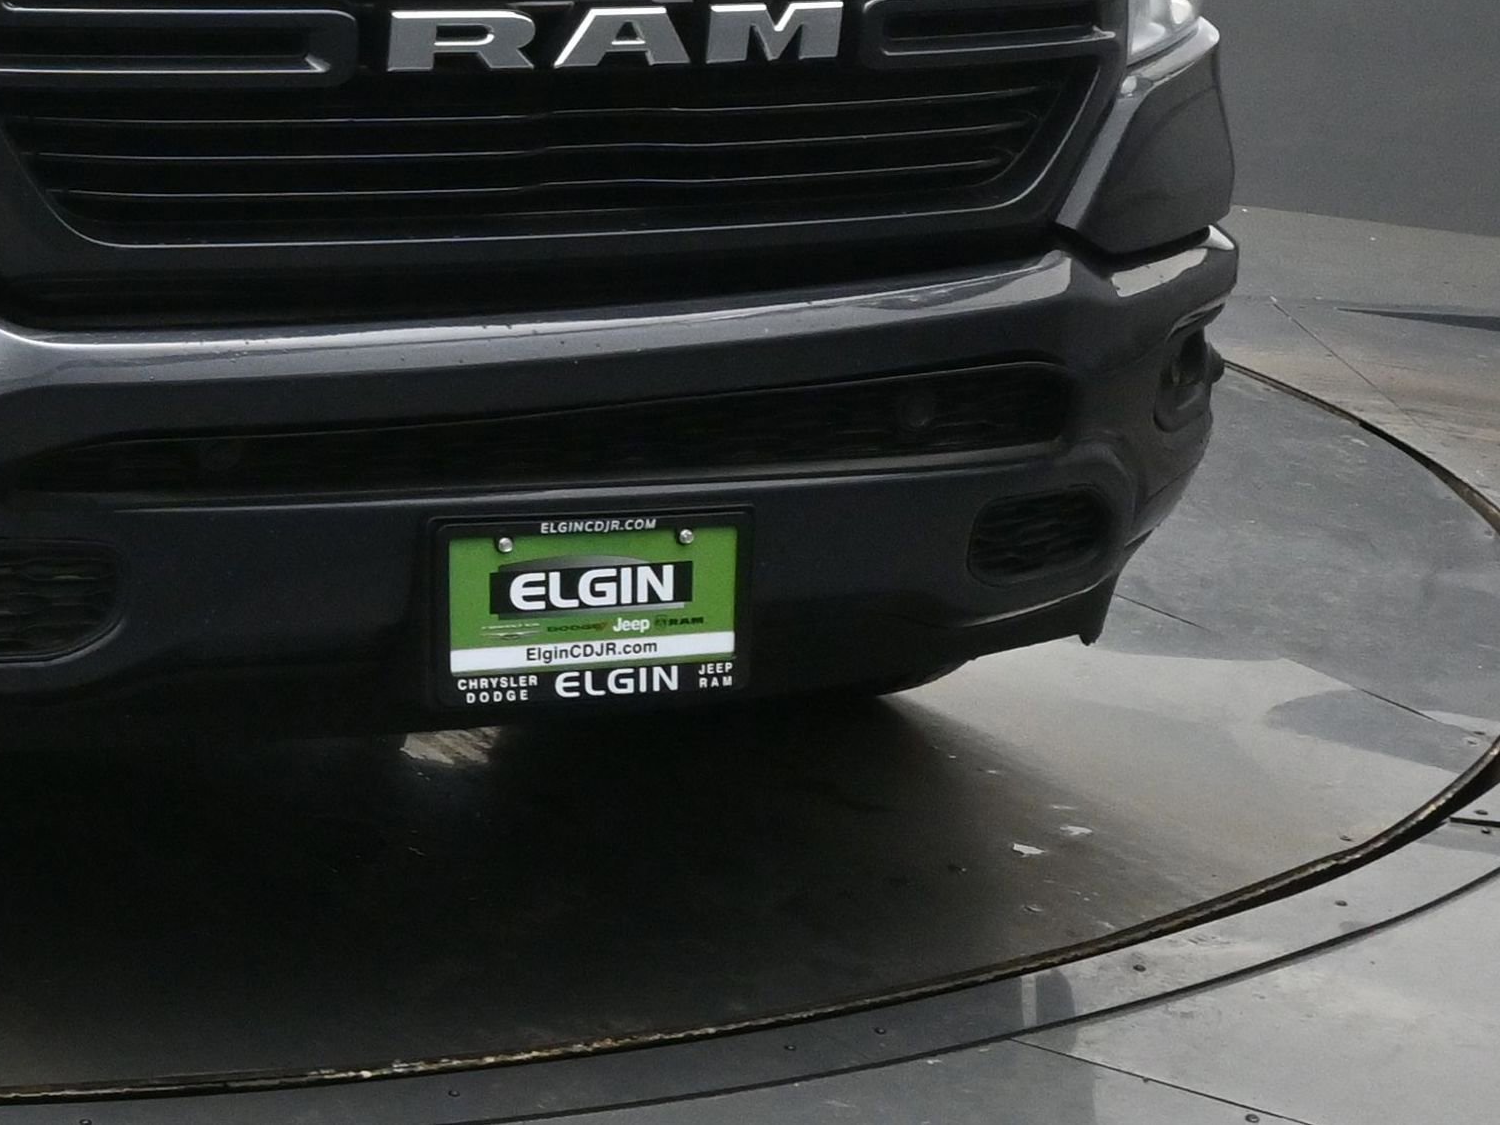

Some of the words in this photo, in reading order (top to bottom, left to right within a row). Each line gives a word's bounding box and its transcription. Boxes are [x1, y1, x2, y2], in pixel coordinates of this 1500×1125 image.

[387, 1, 844, 73] RAM
[540, 518, 657, 535] ELGINCDJR.COM
[508, 564, 675, 611] ELGIN
[612, 617, 651, 633] Jeep
[526, 640, 658, 664] ElginCDJR.com
[698, 662, 734, 676] JEEP
[457, 675, 539, 691] CHRYSLER
[554, 665, 679, 699] ELGIN
[699, 676, 733, 689] RAM
[466, 689, 529, 704] DODGE
